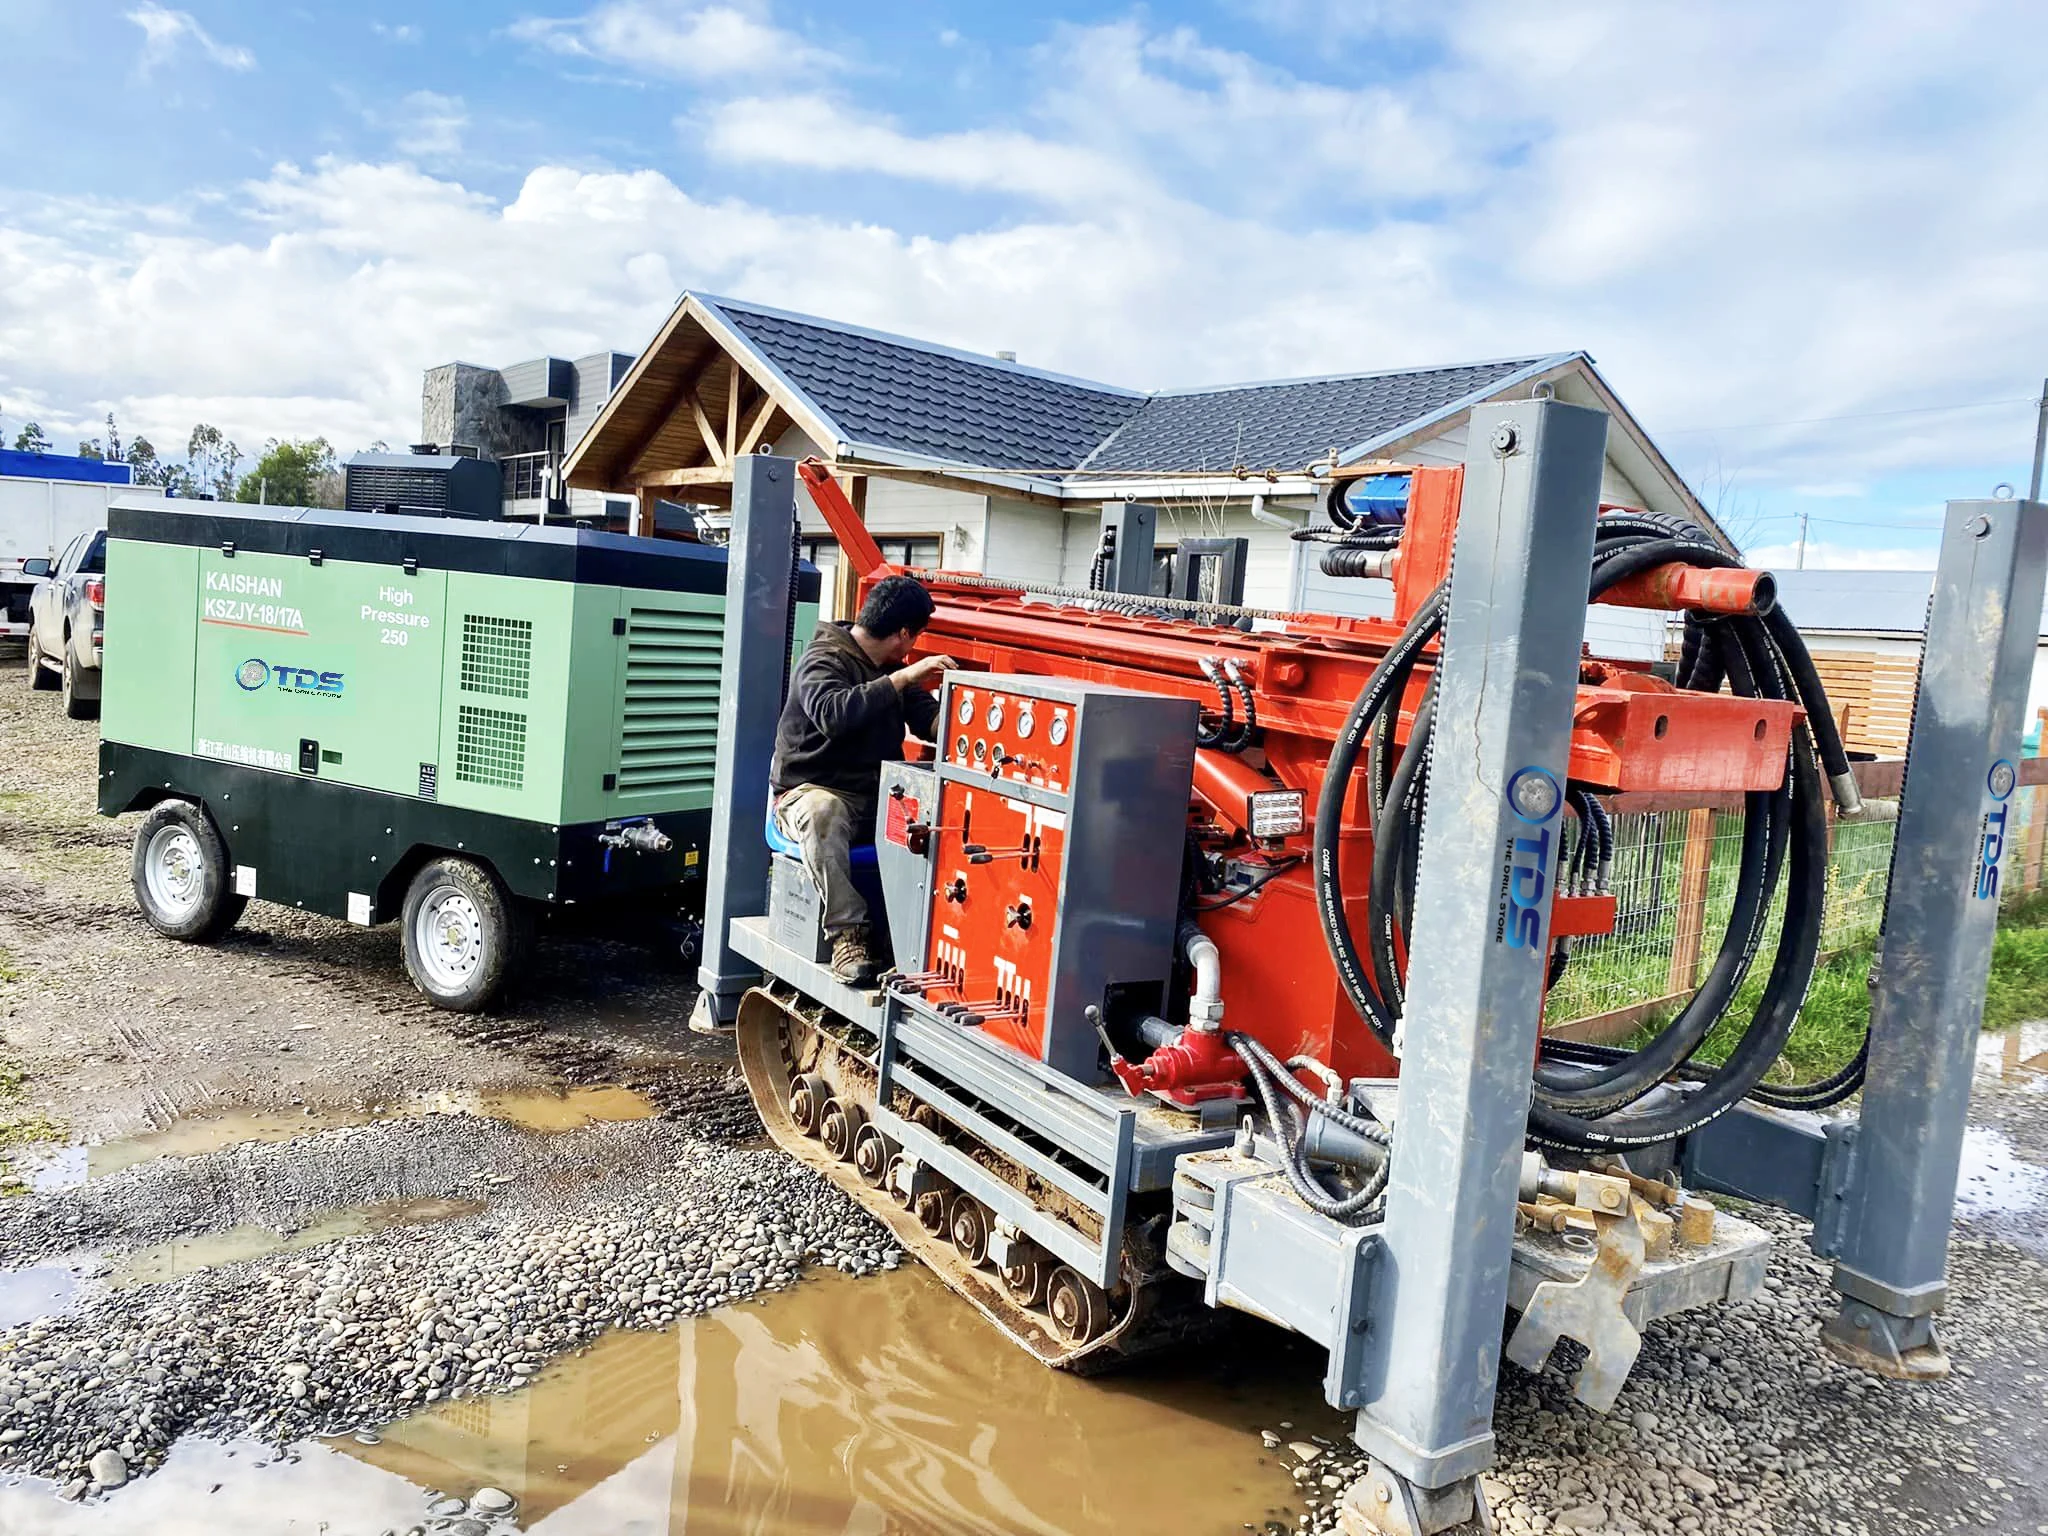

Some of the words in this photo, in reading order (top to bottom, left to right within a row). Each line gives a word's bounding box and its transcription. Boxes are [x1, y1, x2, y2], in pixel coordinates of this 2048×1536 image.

[206, 571, 282, 598] KAISHAN
[379, 586, 414, 607] High
[204, 597, 304, 629] KSZJY-18/17A
[361, 606, 430, 628] Pressure
[380, 629, 408, 647] 250
[272, 665, 345, 693] TDS
[1378, 712, 1388, 741] COMET
[1322, 848, 1331, 877] COMET
[1505, 837, 1514, 861] THE
[1978, 803, 2008, 900] TDS
[1501, 864, 1511, 899] DRILL
[1506, 828, 1549, 950] TDS
[1972, 862, 1981, 898] STORE
[1496, 903, 1506, 943] STORE
[1586, 1132, 1611, 1143] COMET
